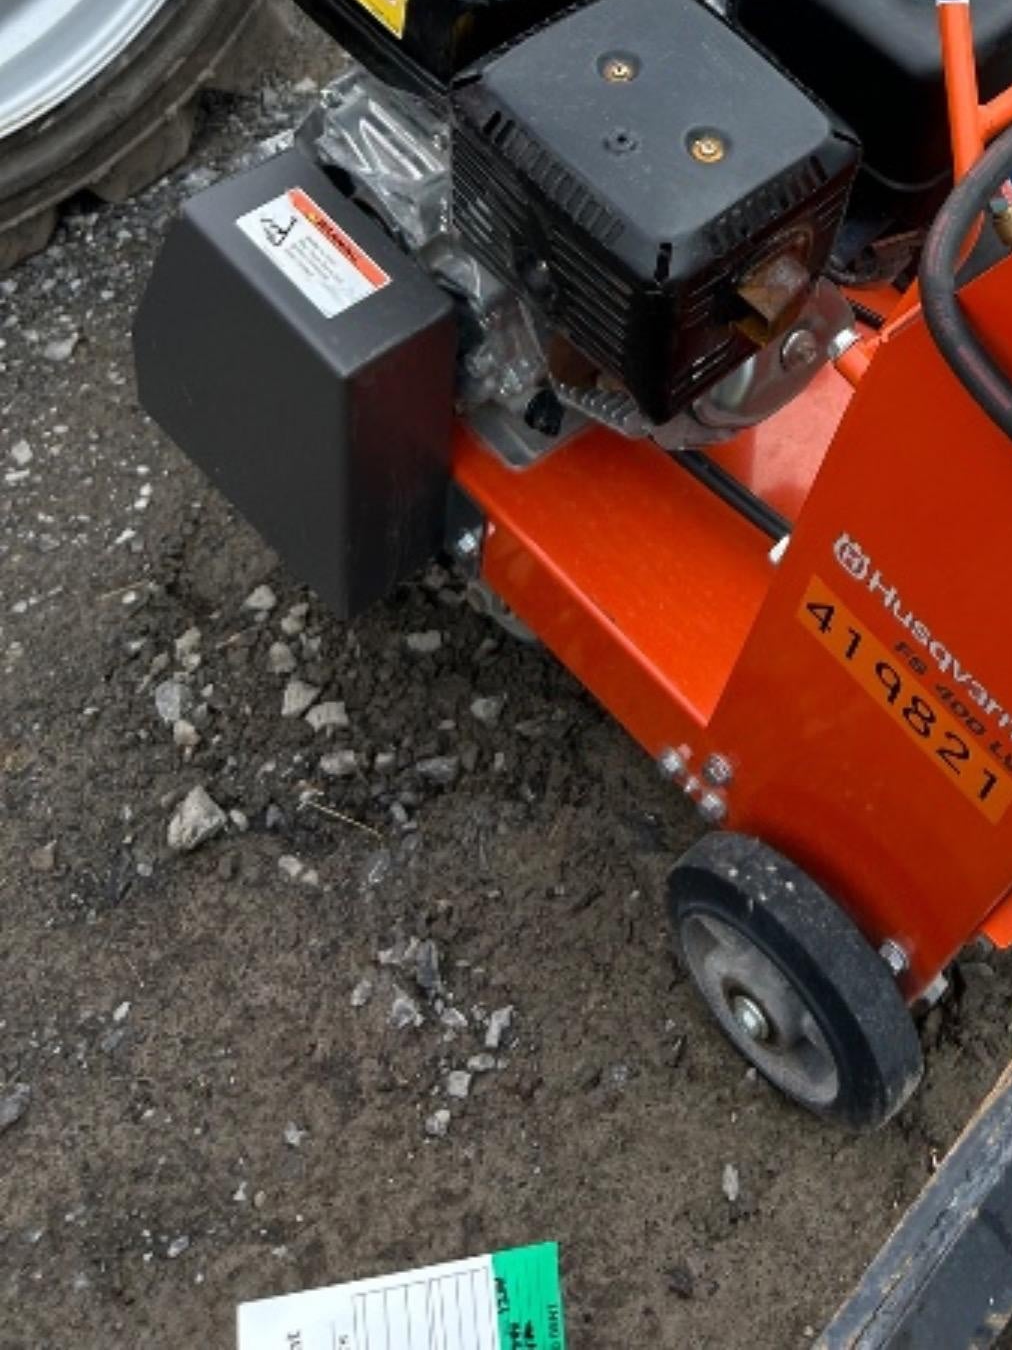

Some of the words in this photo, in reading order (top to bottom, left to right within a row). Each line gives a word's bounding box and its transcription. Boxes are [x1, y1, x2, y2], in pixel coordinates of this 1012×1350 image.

[806, 602, 998, 801] 419821
[895, 641, 928, 676] FS
[936, 684, 987, 736] 400
